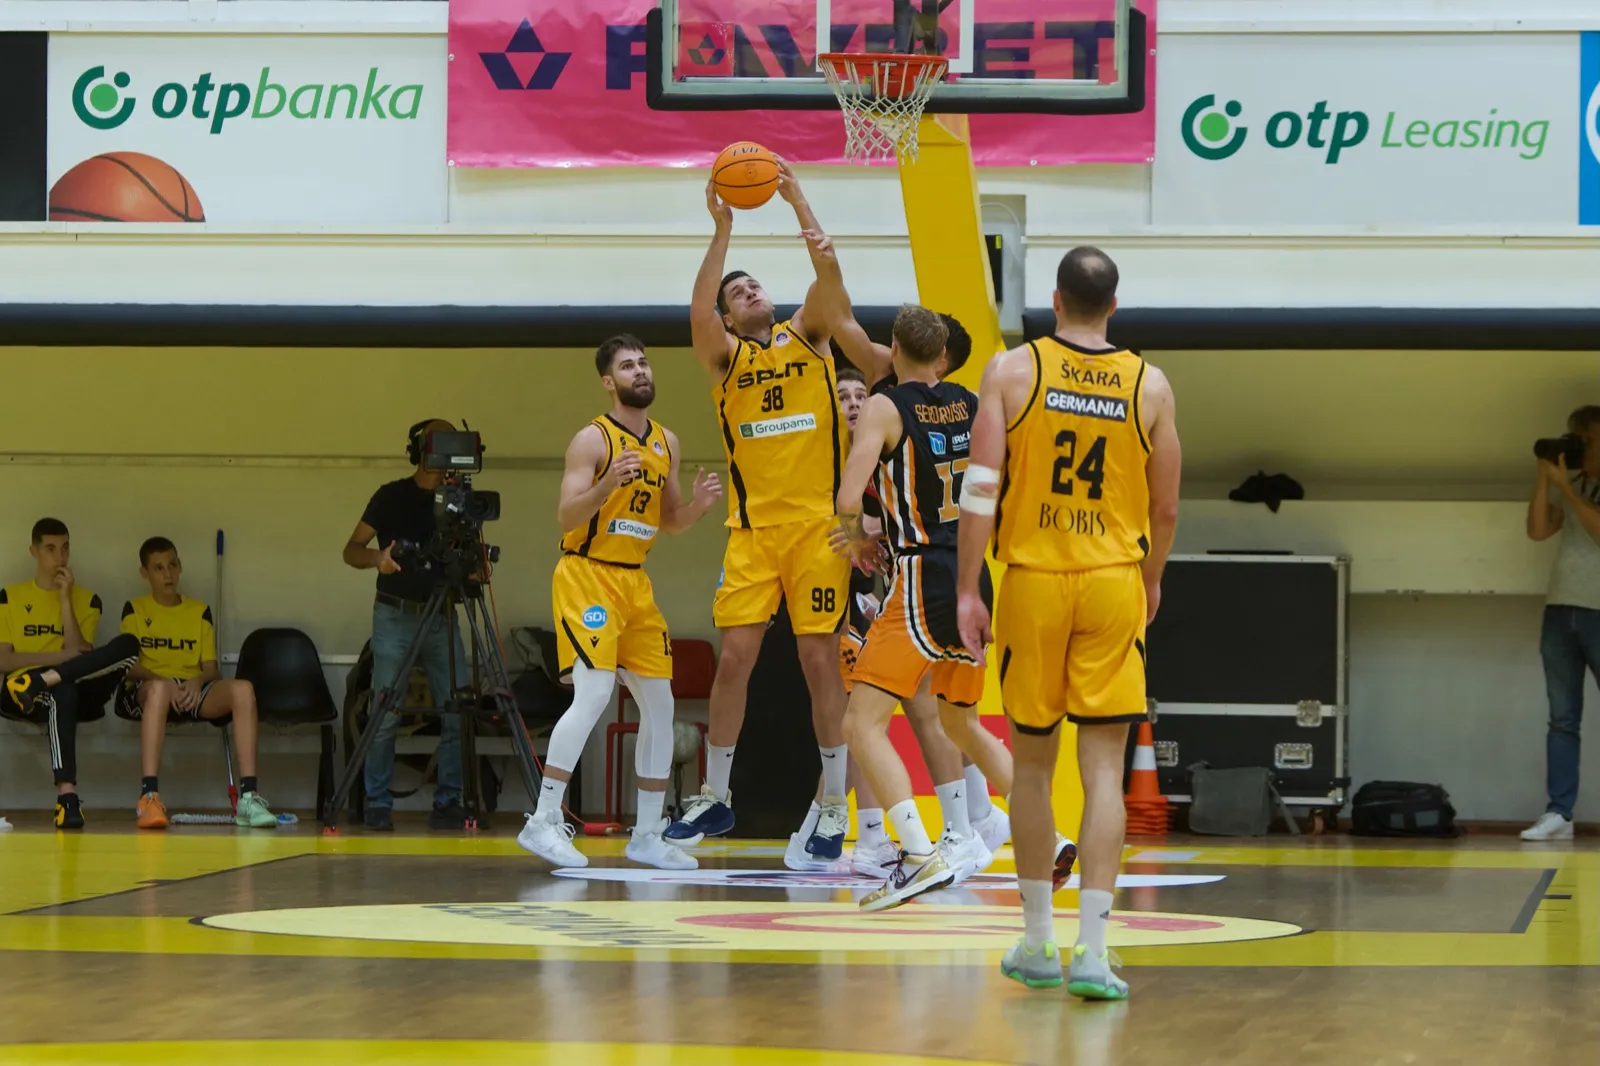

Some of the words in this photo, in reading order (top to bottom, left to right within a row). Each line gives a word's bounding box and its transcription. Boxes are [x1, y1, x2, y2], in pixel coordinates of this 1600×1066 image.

[1265, 100, 1369, 164] otp
[1380, 108, 1550, 160] Leasing
[737, 361, 808, 389] SPLIT
[1061, 358, 1122, 389] ŠKARA
[1046, 392, 1126, 419] GERMANIA
[755, 416, 815, 435] Groupama
[1051, 429, 1107, 500] 24
[629, 490, 652, 514] 13
[1039, 502, 1106, 537] BOBIS
[811, 587, 836, 613] 98
[583, 611, 606, 622] GDi
[23, 624, 64, 636] SPLI
[140, 637, 197, 650] SPLIT
